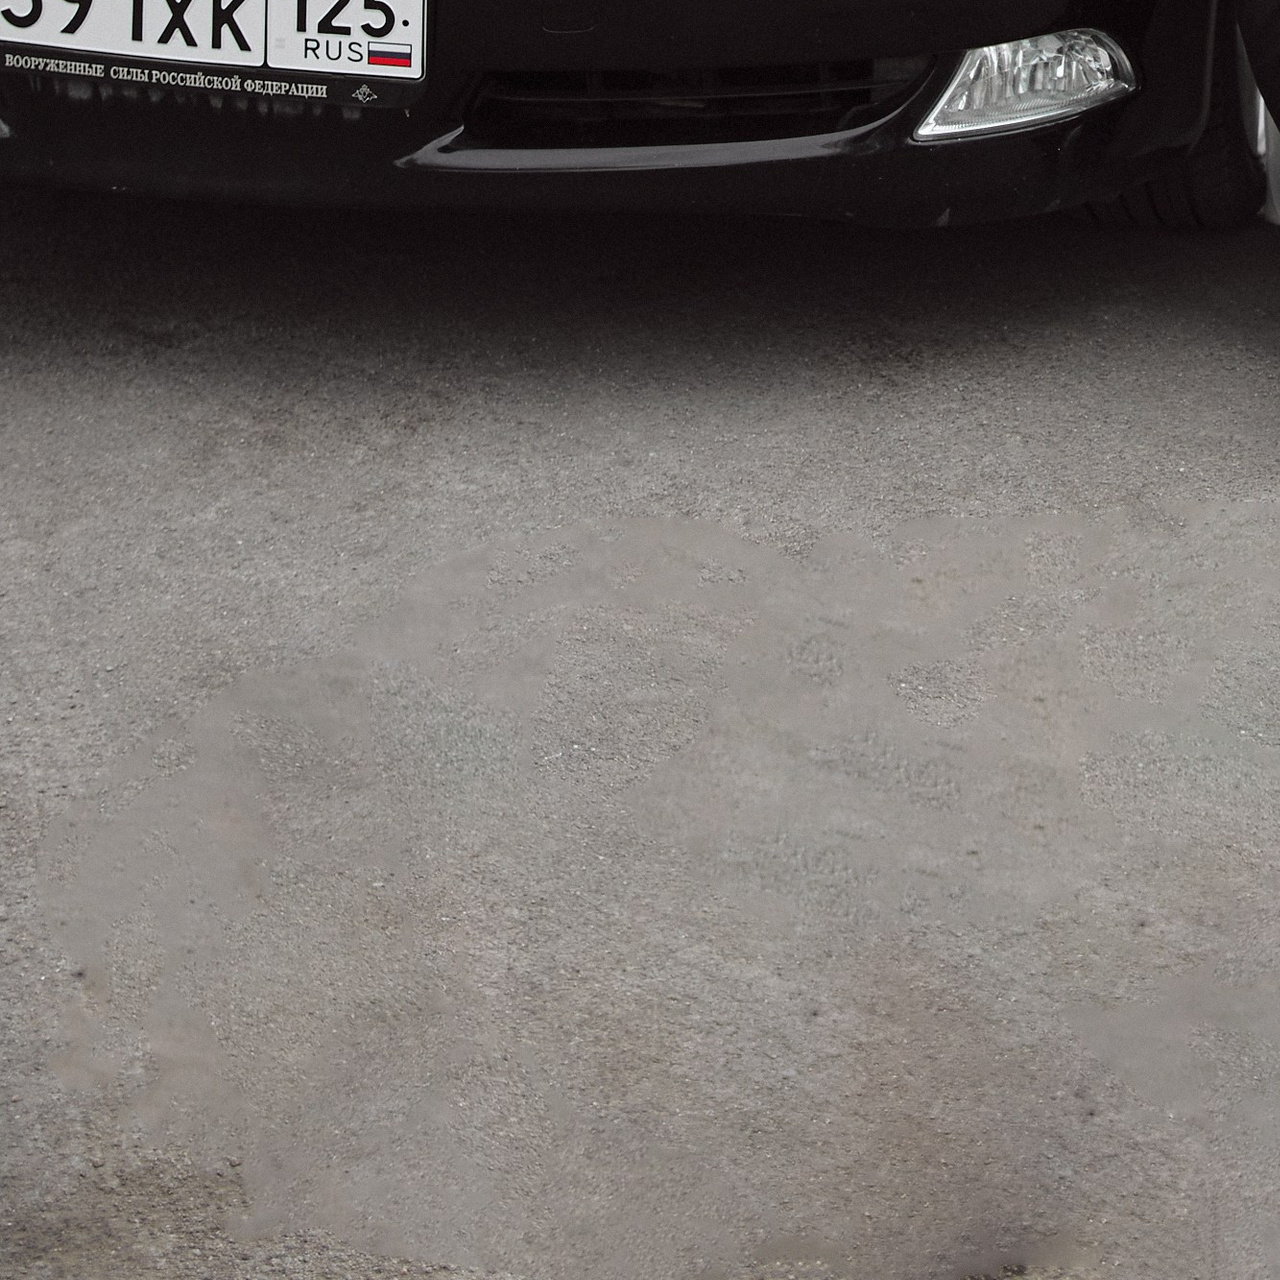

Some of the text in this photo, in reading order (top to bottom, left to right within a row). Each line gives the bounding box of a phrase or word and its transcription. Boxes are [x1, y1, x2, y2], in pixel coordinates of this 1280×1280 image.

[303, 38, 364, 63] RUS
[4, 52, 328, 99] ВООРУЖЕННЫЕ СИЛЫ РОССИЙСКОЙ ФЕДЕРАЦИИ
